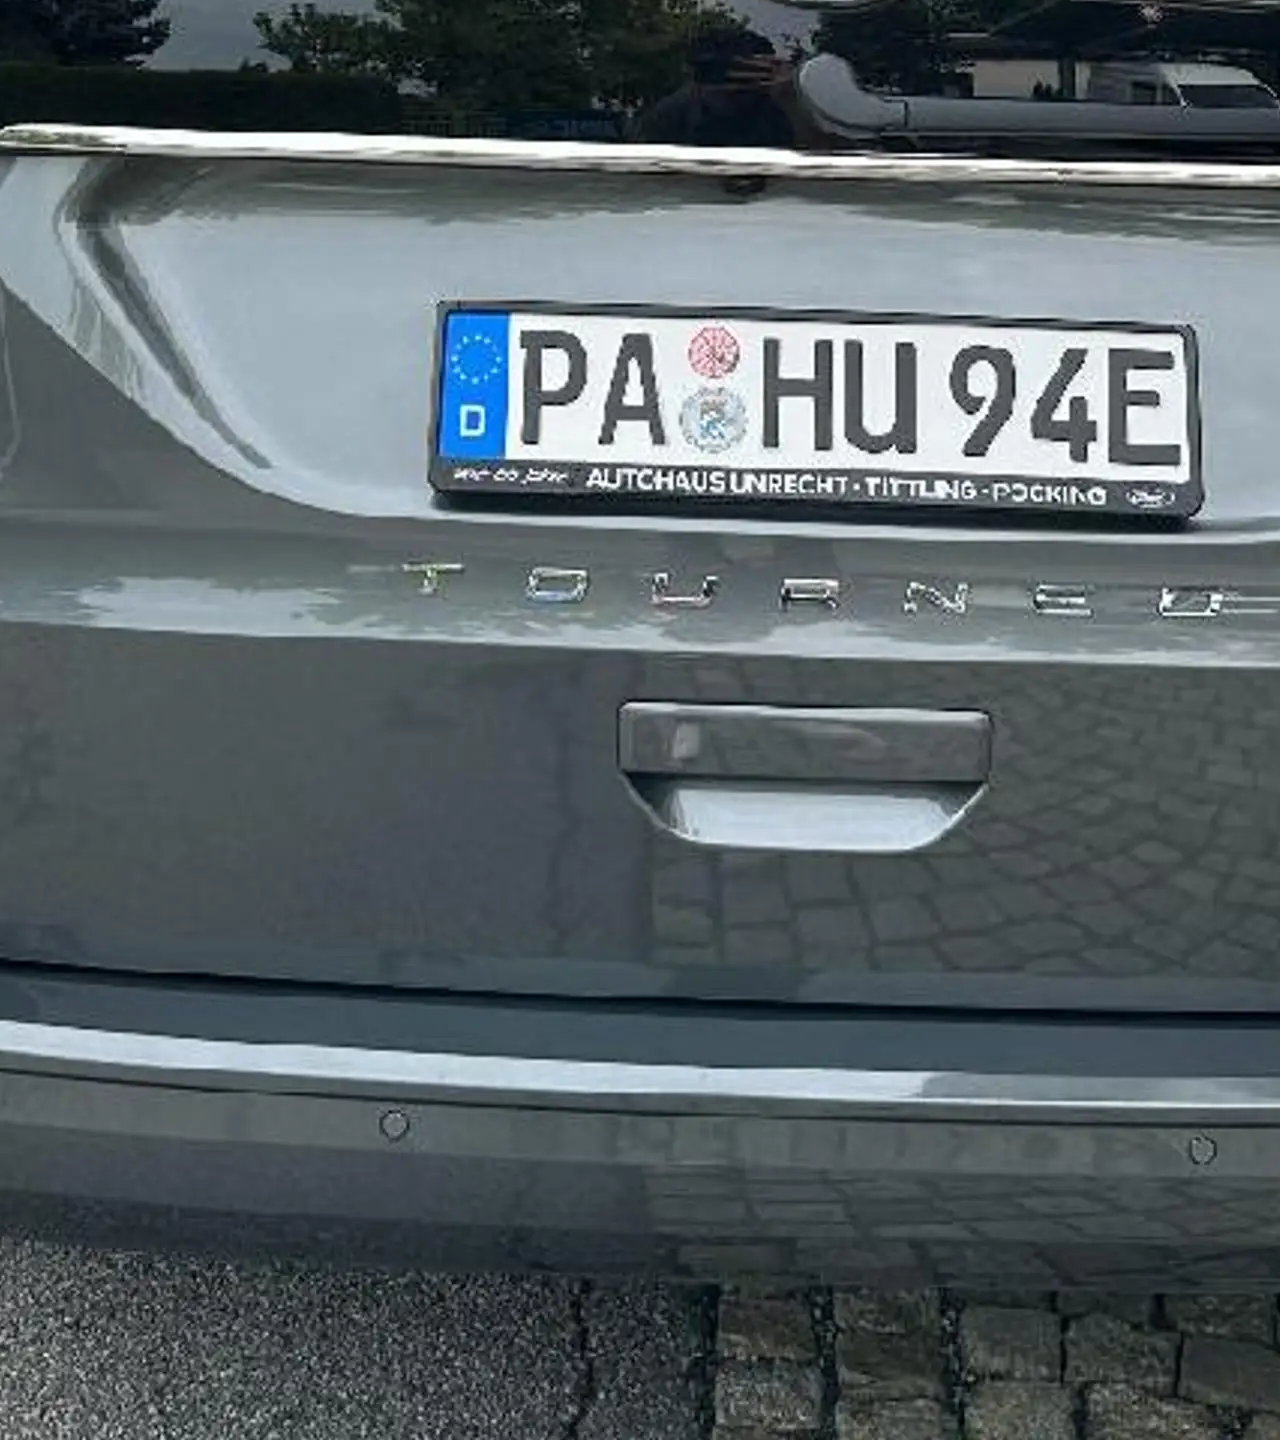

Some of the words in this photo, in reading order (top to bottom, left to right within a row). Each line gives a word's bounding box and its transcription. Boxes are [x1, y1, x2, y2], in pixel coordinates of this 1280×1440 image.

[518, 329, 667, 446] PA
[761, 336, 919, 455] HU
[948, 344, 1182, 466] 94E
[458, 405, 486, 437] D
[585, 467, 726, 494] AUTOHAUS
[729, 471, 849, 496] UNRECHT
[864, 476, 977, 500] TITTLING
[404, 562, 1221, 618] TOURNEO
